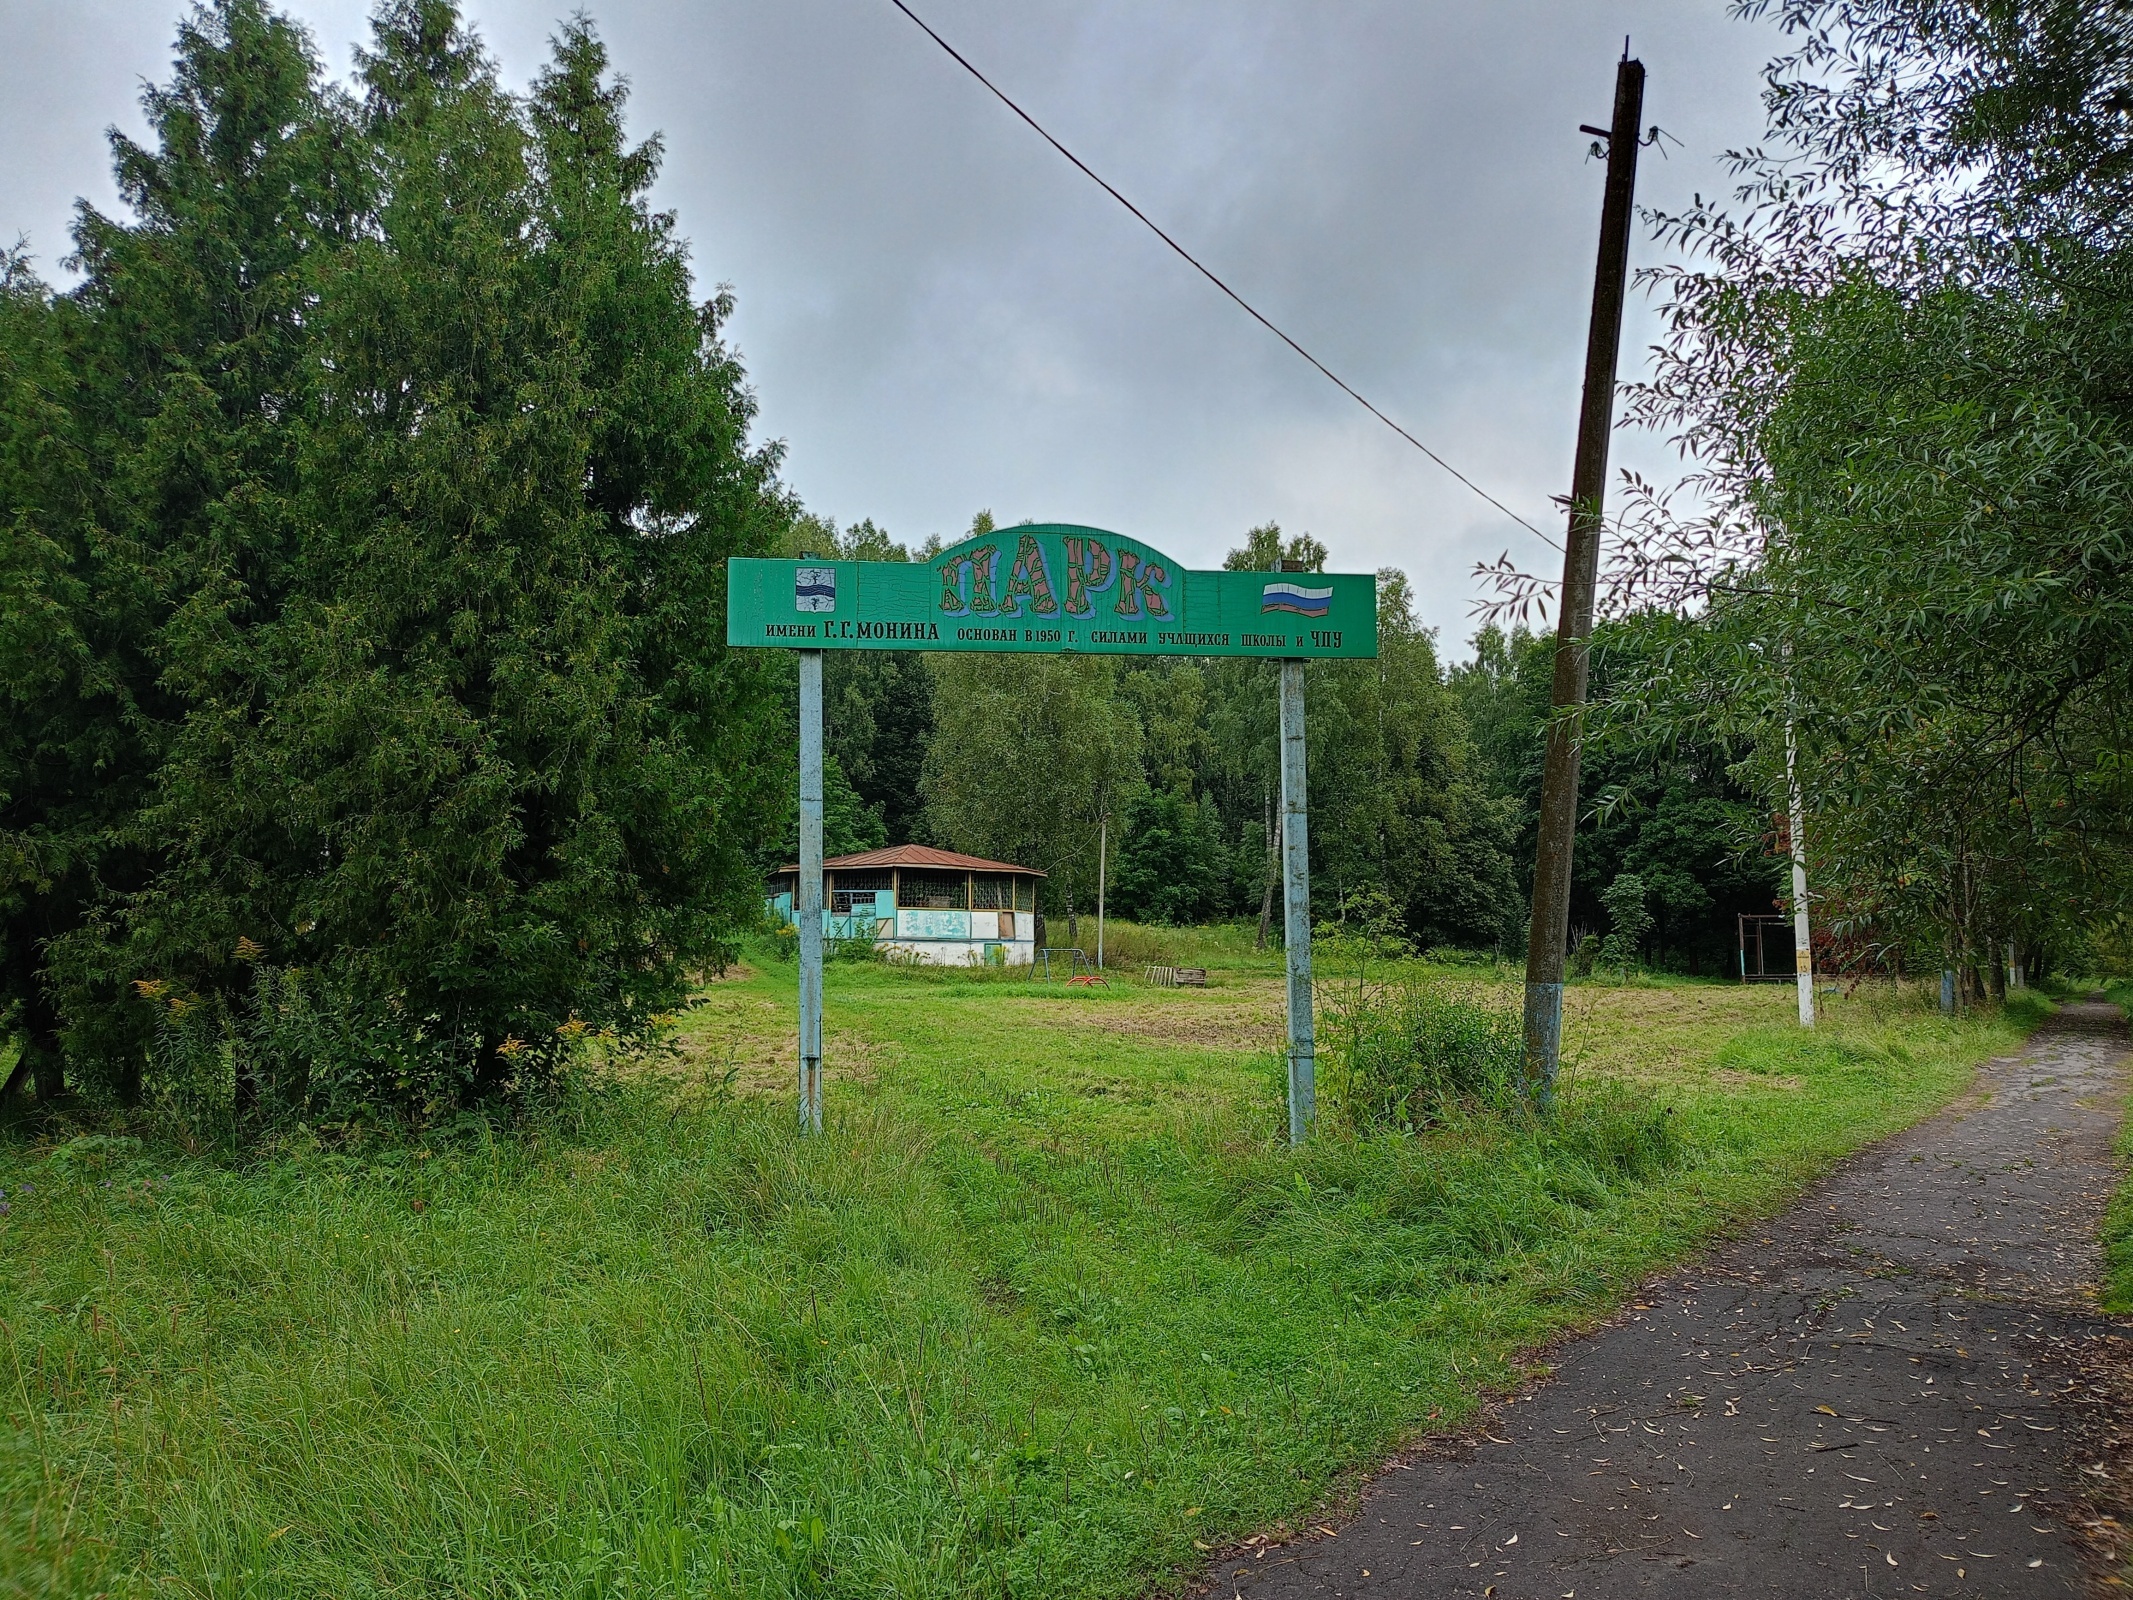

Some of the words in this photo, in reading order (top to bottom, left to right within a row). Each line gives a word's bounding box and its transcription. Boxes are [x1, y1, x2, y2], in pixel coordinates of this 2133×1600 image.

[938, 534, 1176, 622] ПАРК
[765, 624, 816, 637] ИМЕНИ
[957, 628, 1017, 642] ОСНОВАН
[1025, 629, 1033, 642] В
[1036, 629, 1061, 642] 1950
[1068, 631, 1079, 643] Г.
[1091, 631, 1148, 644] СИЛАМИ
[1158, 632, 1230, 647] УЧАЩИХСЯ
[1241, 633, 1286, 647] ШКОЛЫ
[1310, 630, 1343, 648] ЧПУ
